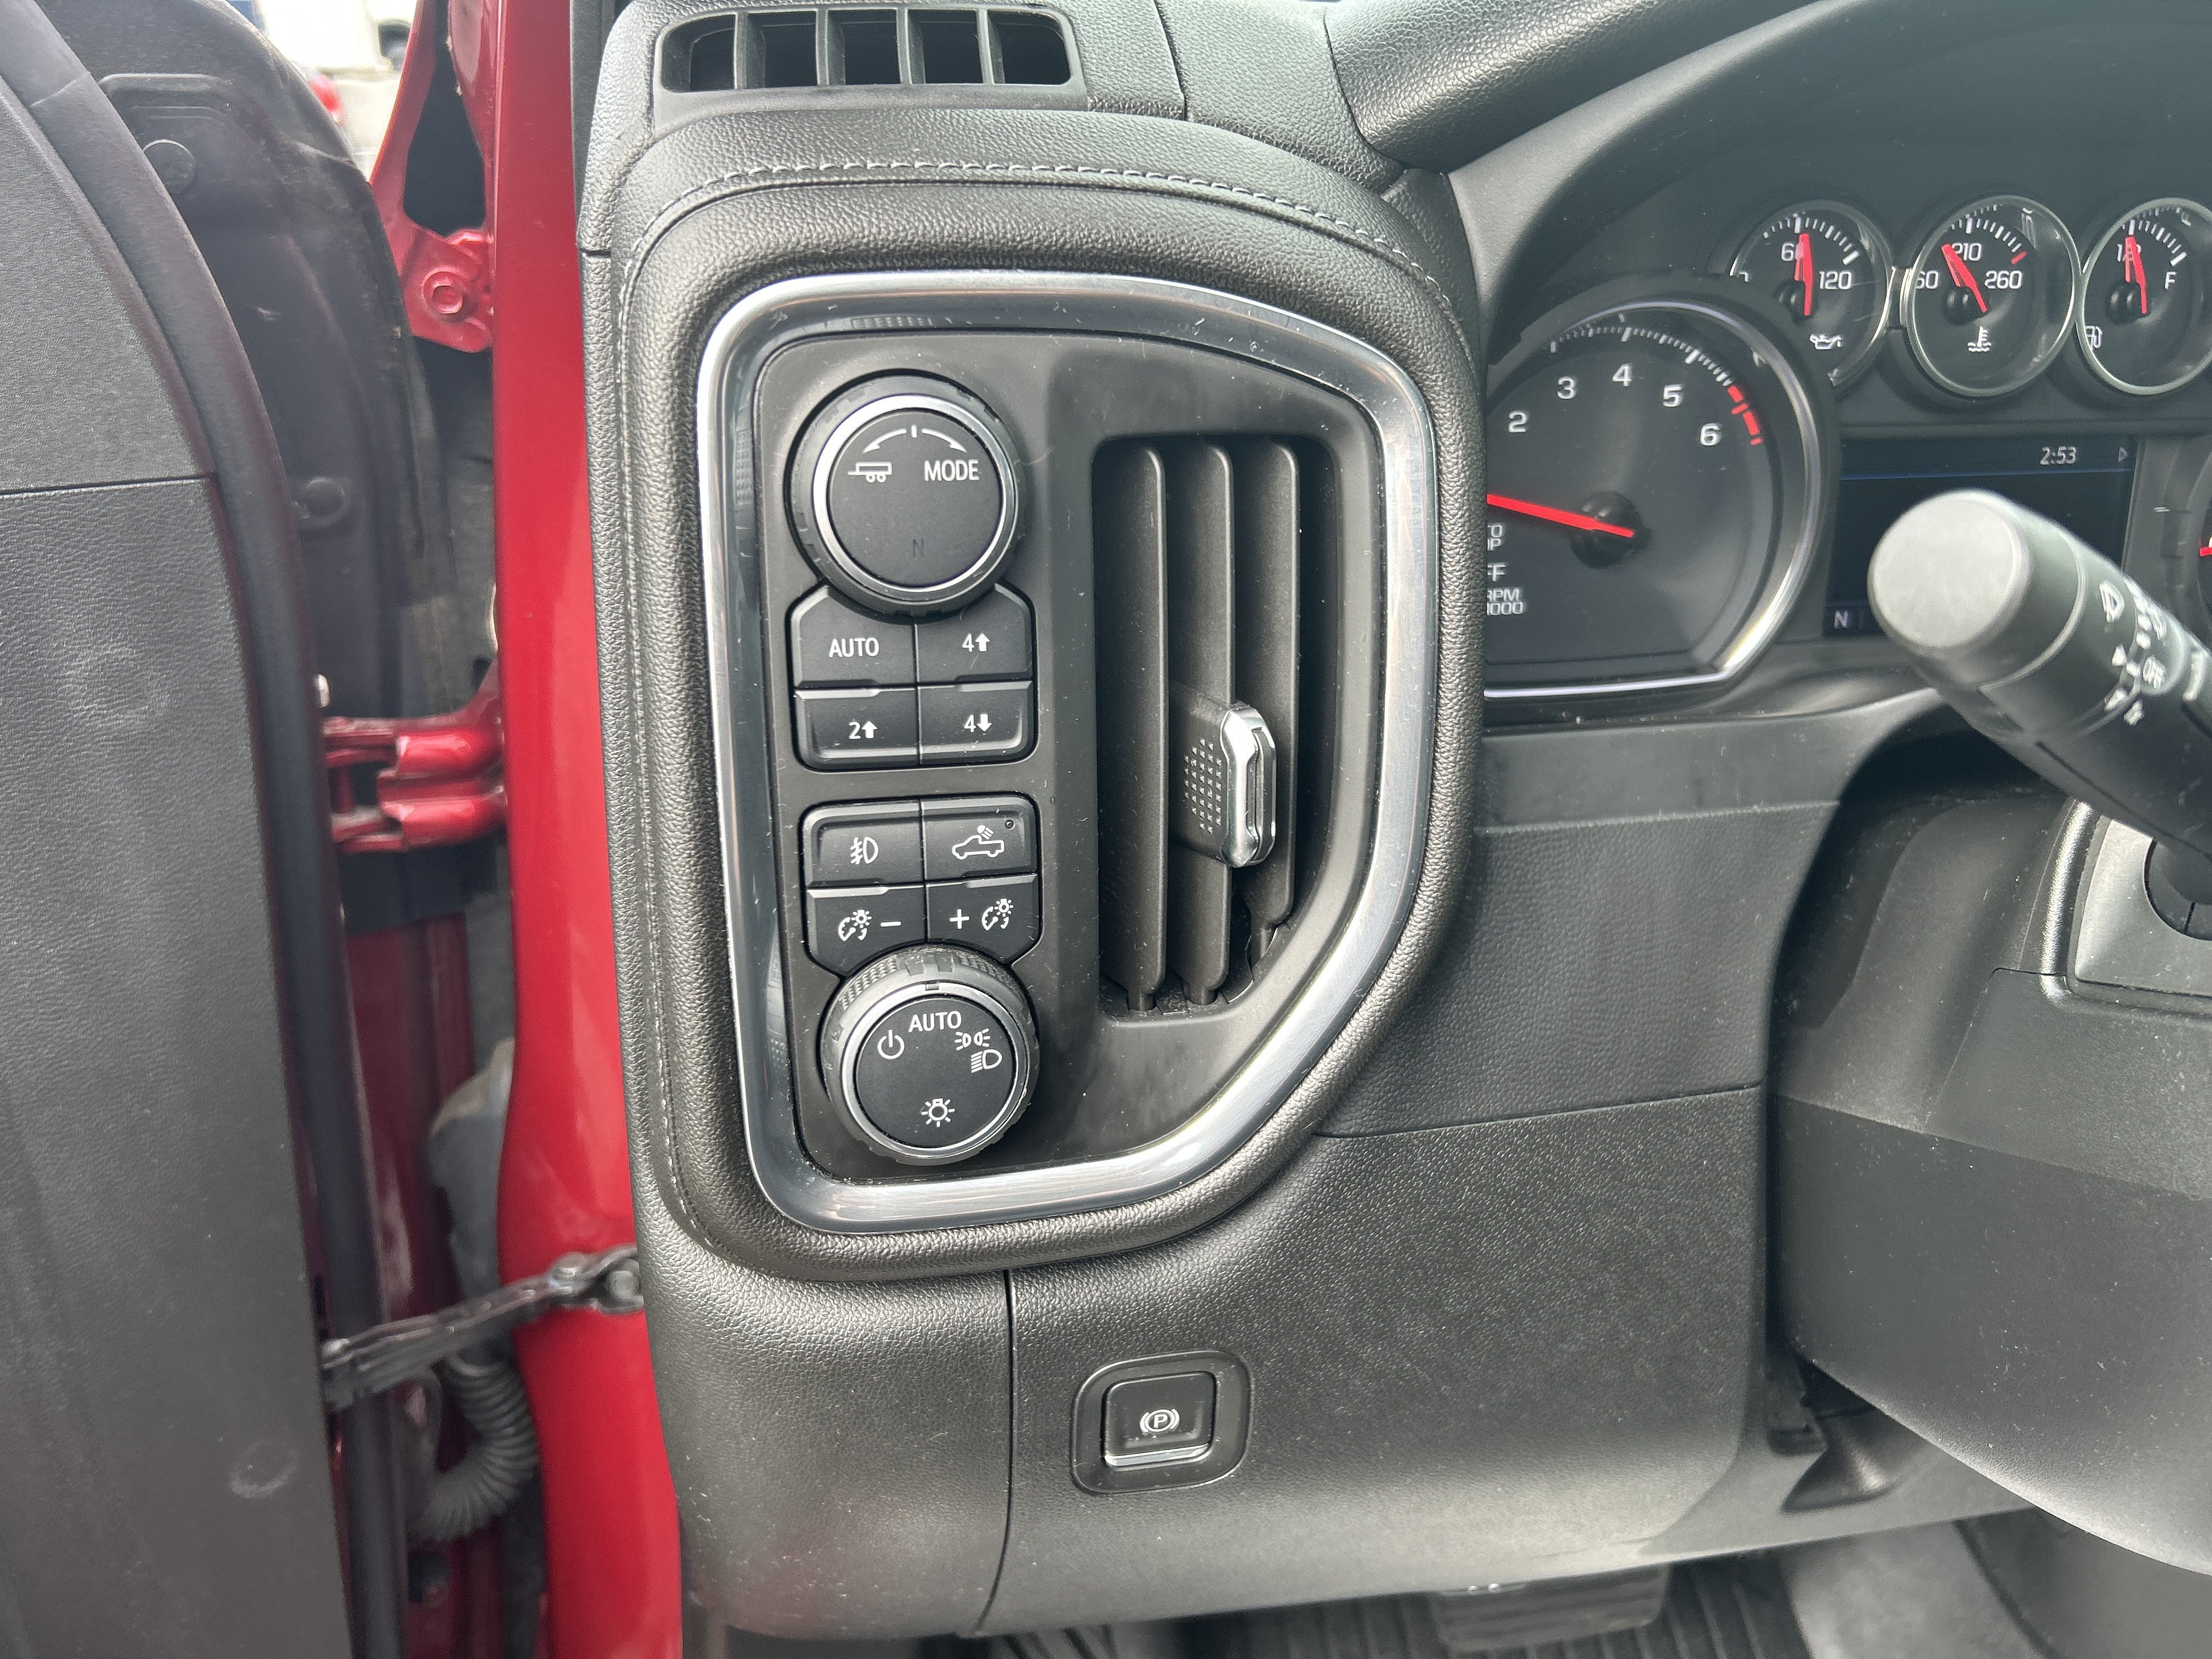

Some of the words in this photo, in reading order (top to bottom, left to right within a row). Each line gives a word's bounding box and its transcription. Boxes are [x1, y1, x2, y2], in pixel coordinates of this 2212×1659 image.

[1819, 270, 1852, 290] 120
[1984, 270, 2023, 289] 260
[2165, 271, 2177, 289] F
[1612, 363, 1633, 386] 4
[1556, 376, 1577, 399] 3
[1662, 383, 1683, 407] 5
[1508, 410, 1528, 433] 2
[1700, 422, 1721, 446] 6
[2039, 445, 2077, 465] 2:53
[924, 459, 980, 481] MODE
[1834, 610, 1850, 629] N
[828, 637, 879, 658] AUTO
[908, 1011, 962, 1032] AUTO
